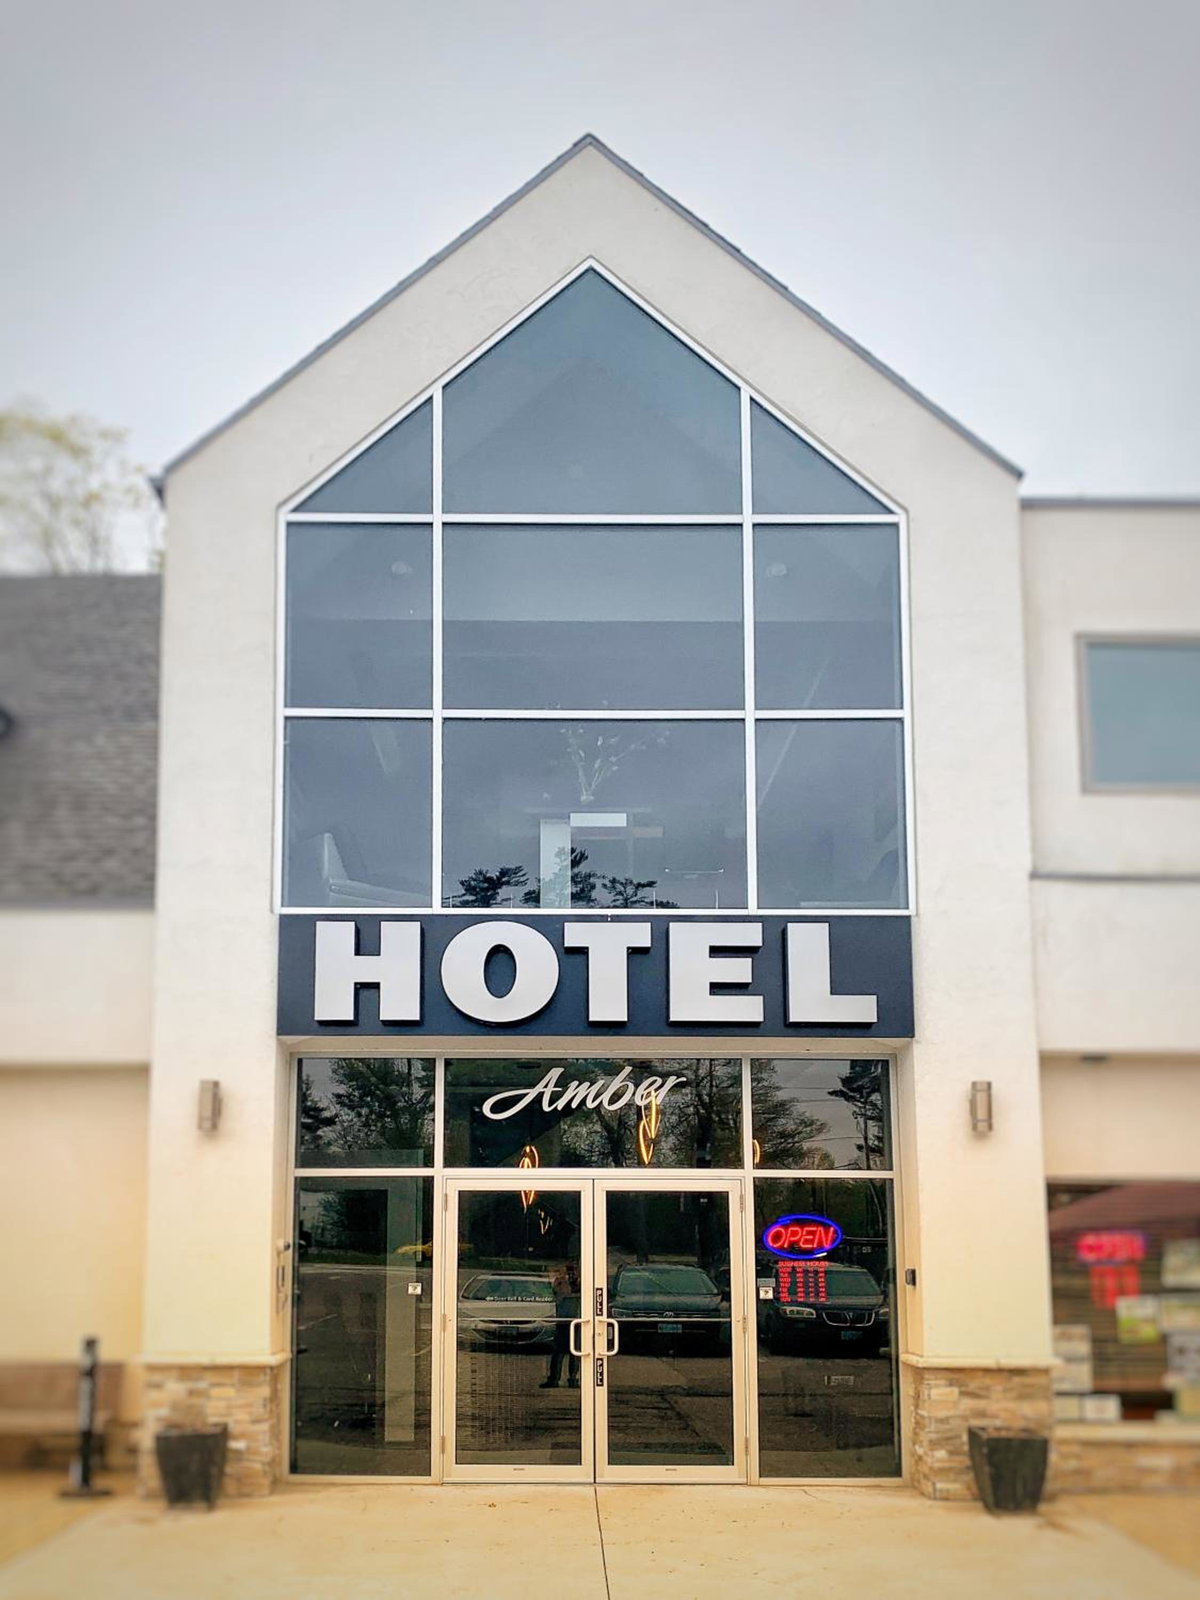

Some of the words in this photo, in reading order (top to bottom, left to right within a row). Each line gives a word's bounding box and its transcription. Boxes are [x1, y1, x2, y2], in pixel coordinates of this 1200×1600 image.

[314, 920, 879, 1024] HOTEL
[482, 1066, 687, 1120] Amber
[768, 1226, 835, 1249] OPEN
